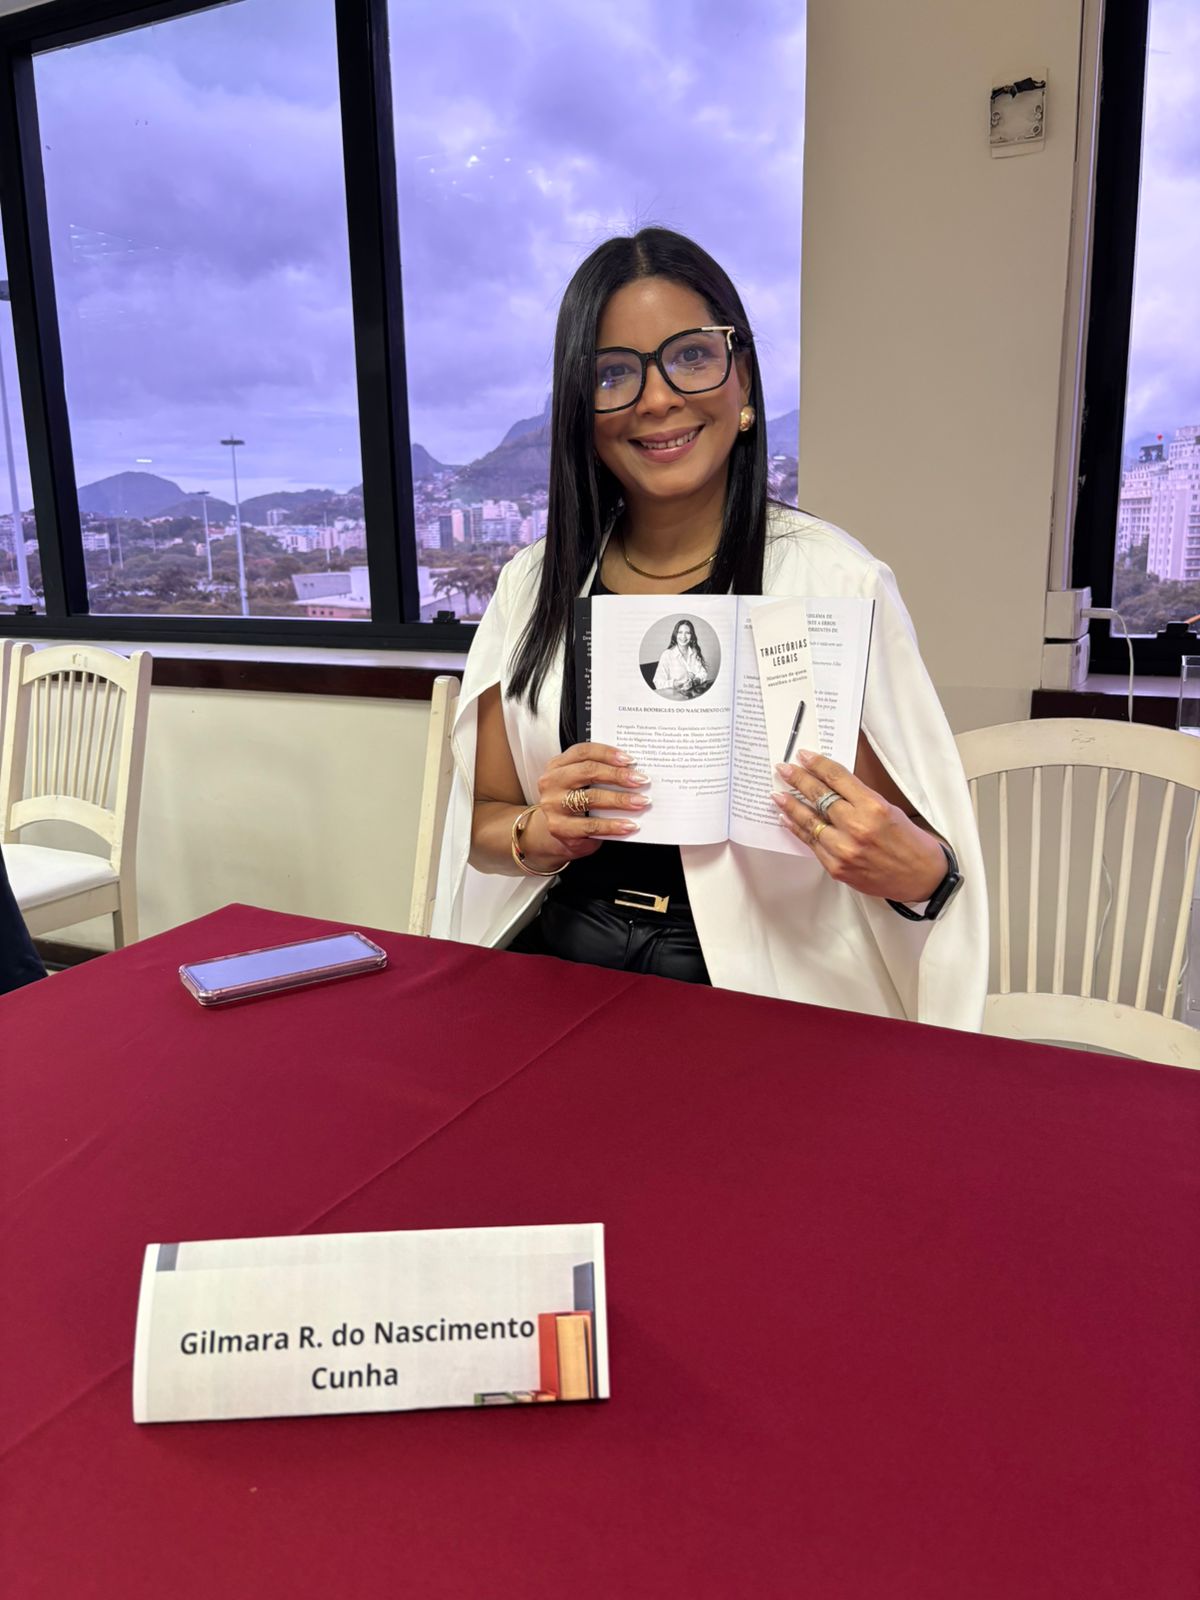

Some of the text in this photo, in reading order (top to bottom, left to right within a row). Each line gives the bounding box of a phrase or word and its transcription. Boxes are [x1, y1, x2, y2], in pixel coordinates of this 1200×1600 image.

[772, 653, 798, 667] LEGAIS
[618, 705, 643, 713] GILMARA
[180, 1318, 535, 1355] Gilmara R. do Nascimento
[312, 1364, 398, 1390] Cunha
